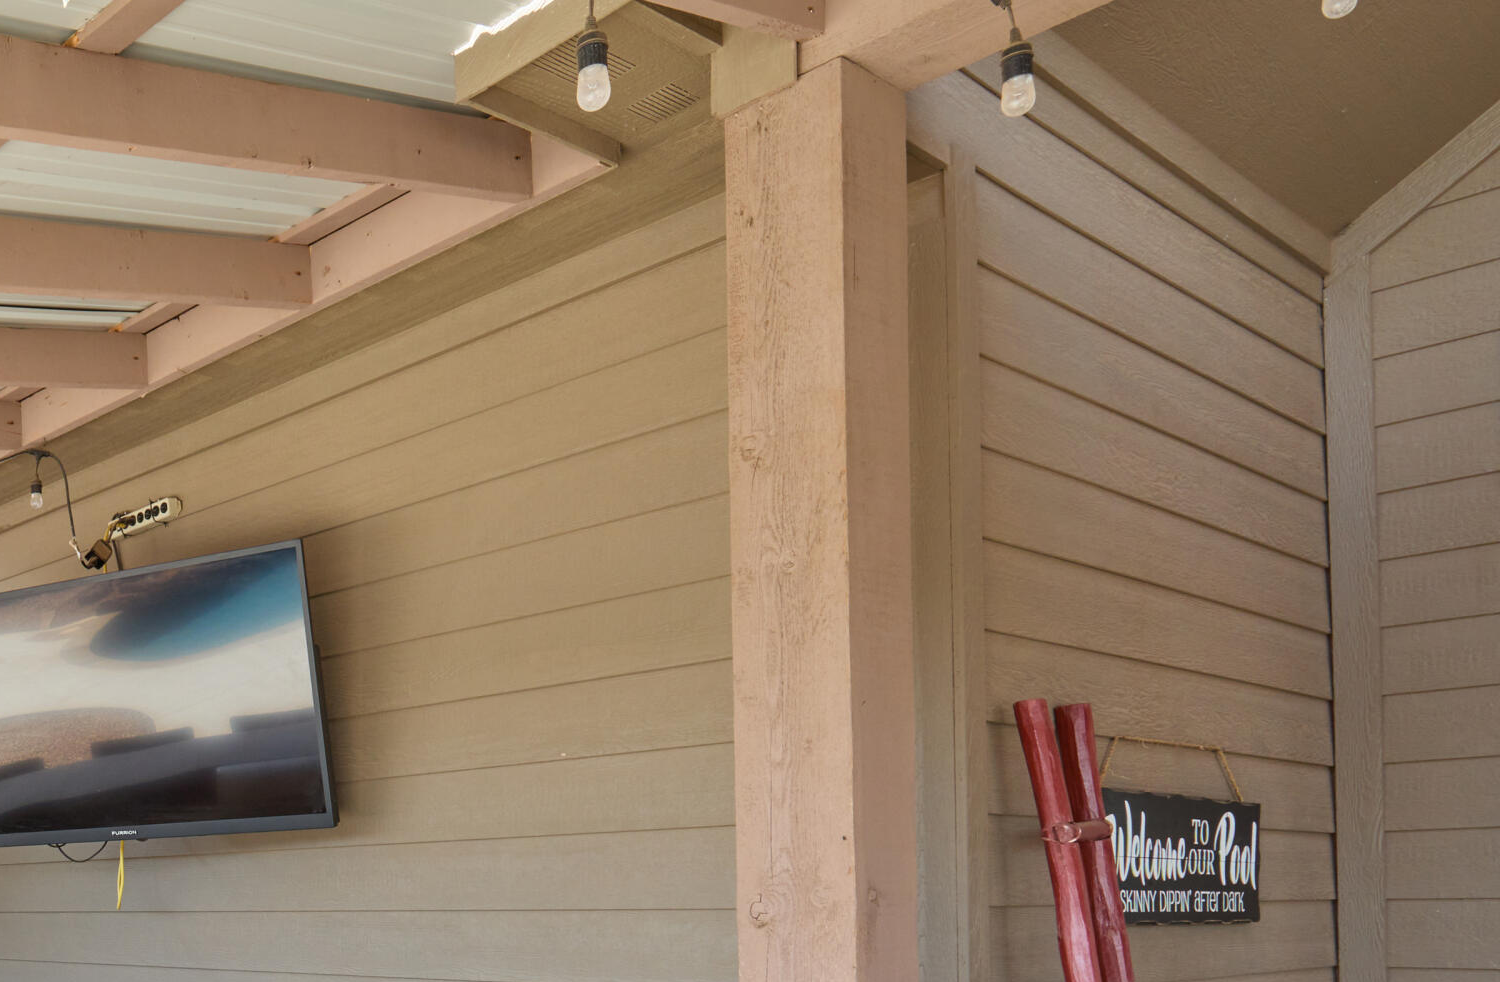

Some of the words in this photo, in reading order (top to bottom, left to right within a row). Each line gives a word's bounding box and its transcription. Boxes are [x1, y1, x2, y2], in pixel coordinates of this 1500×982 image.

[1105, 800, 1189, 886] Welcome
[1191, 818, 1210, 846] TO
[1187, 848, 1216, 876] OUR
[1214, 811, 1258, 890] Pool
[1120, 889, 1156, 913] SKINNY
[1159, 889, 1192, 913] DIPPIN'
